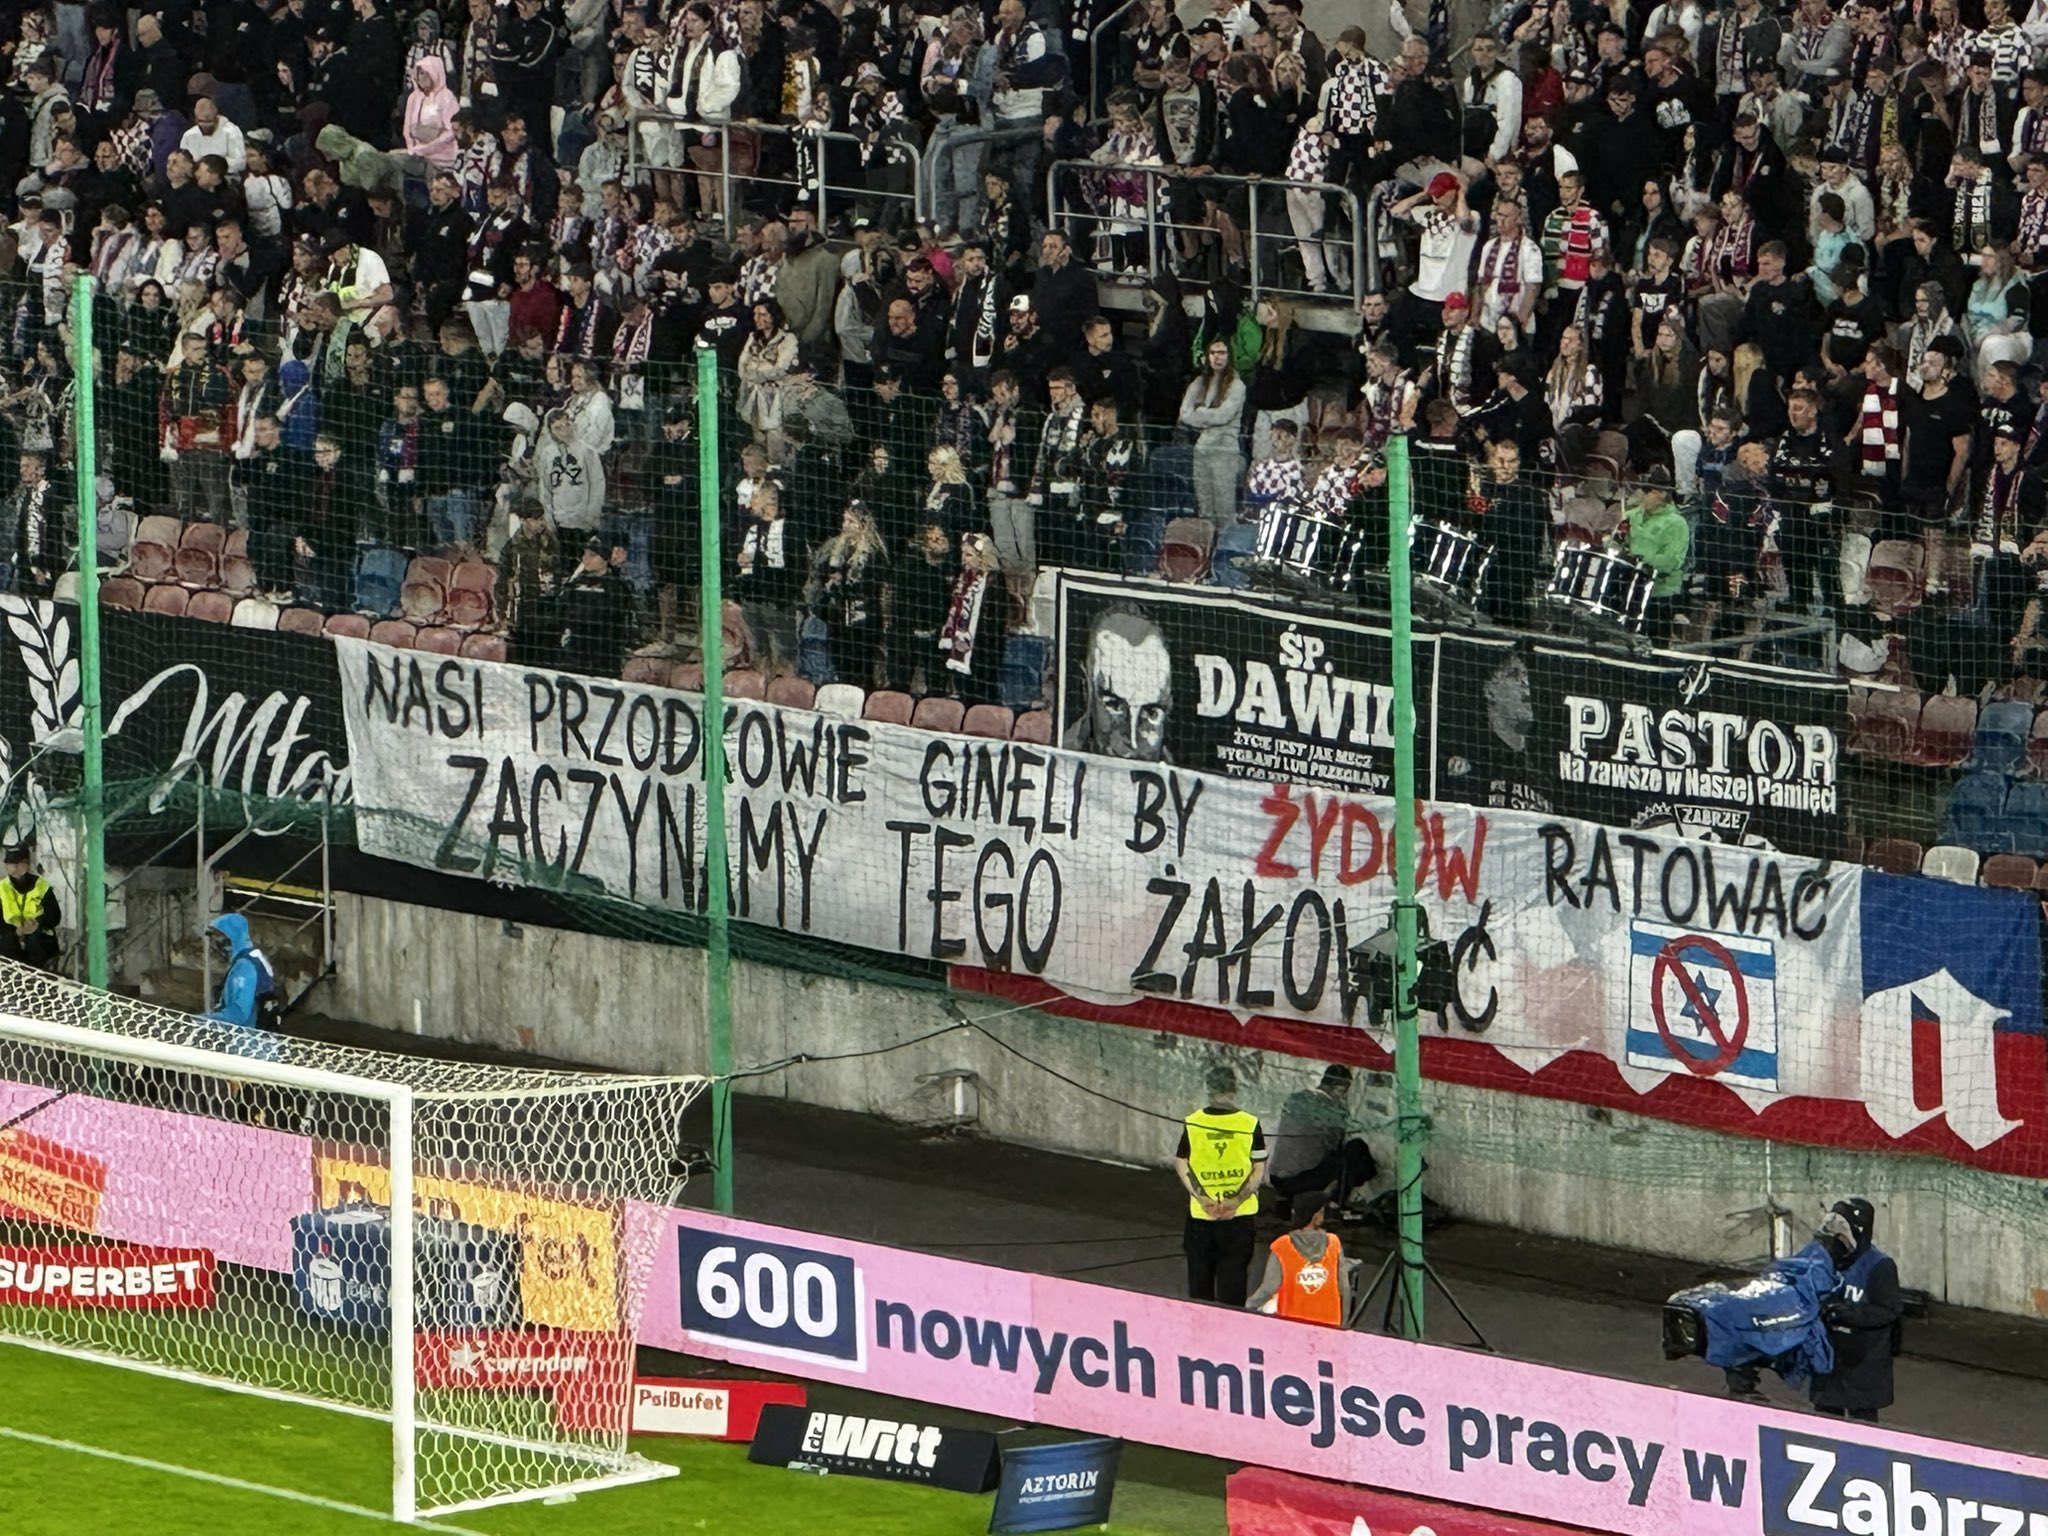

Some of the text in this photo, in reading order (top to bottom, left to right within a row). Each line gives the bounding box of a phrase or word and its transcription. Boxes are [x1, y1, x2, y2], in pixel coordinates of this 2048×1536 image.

[1274, 737, 1307, 757] JEST
[1563, 695, 1838, 787] PASTOR
[365, 650, 485, 739] NASI
[920, 740, 1086, 843] GINĘLI
[1125, 770, 1203, 857] BY
[1537, 823, 1834, 941] RATOWAĆ
[1282, 756, 1309, 775] LUB
[1309, 761, 1391, 789] PRZEGRANY
[1559, 750, 1838, 815] Na zawsze w Naszej Pamięci
[1682, 807, 1741, 829] ZABRZE
[885, 820, 1062, 974] TEGO
[1130, 864, 1499, 1033] ŻAŁOĆ
[0, 1259, 201, 1296] SUPERBET
[697, 1245, 839, 1339] 600
[875, 1297, 1156, 1398] nowych
[1179, 1348, 1427, 1449] miejsc
[1446, 1403, 1664, 1507] pracy
[1684, 1447, 1747, 1509] w
[1786, 1444, 2048, 1536] Zabrz
[821, 1413, 943, 1468] Witt
[1020, 1470, 1100, 1495] AZTORIN
